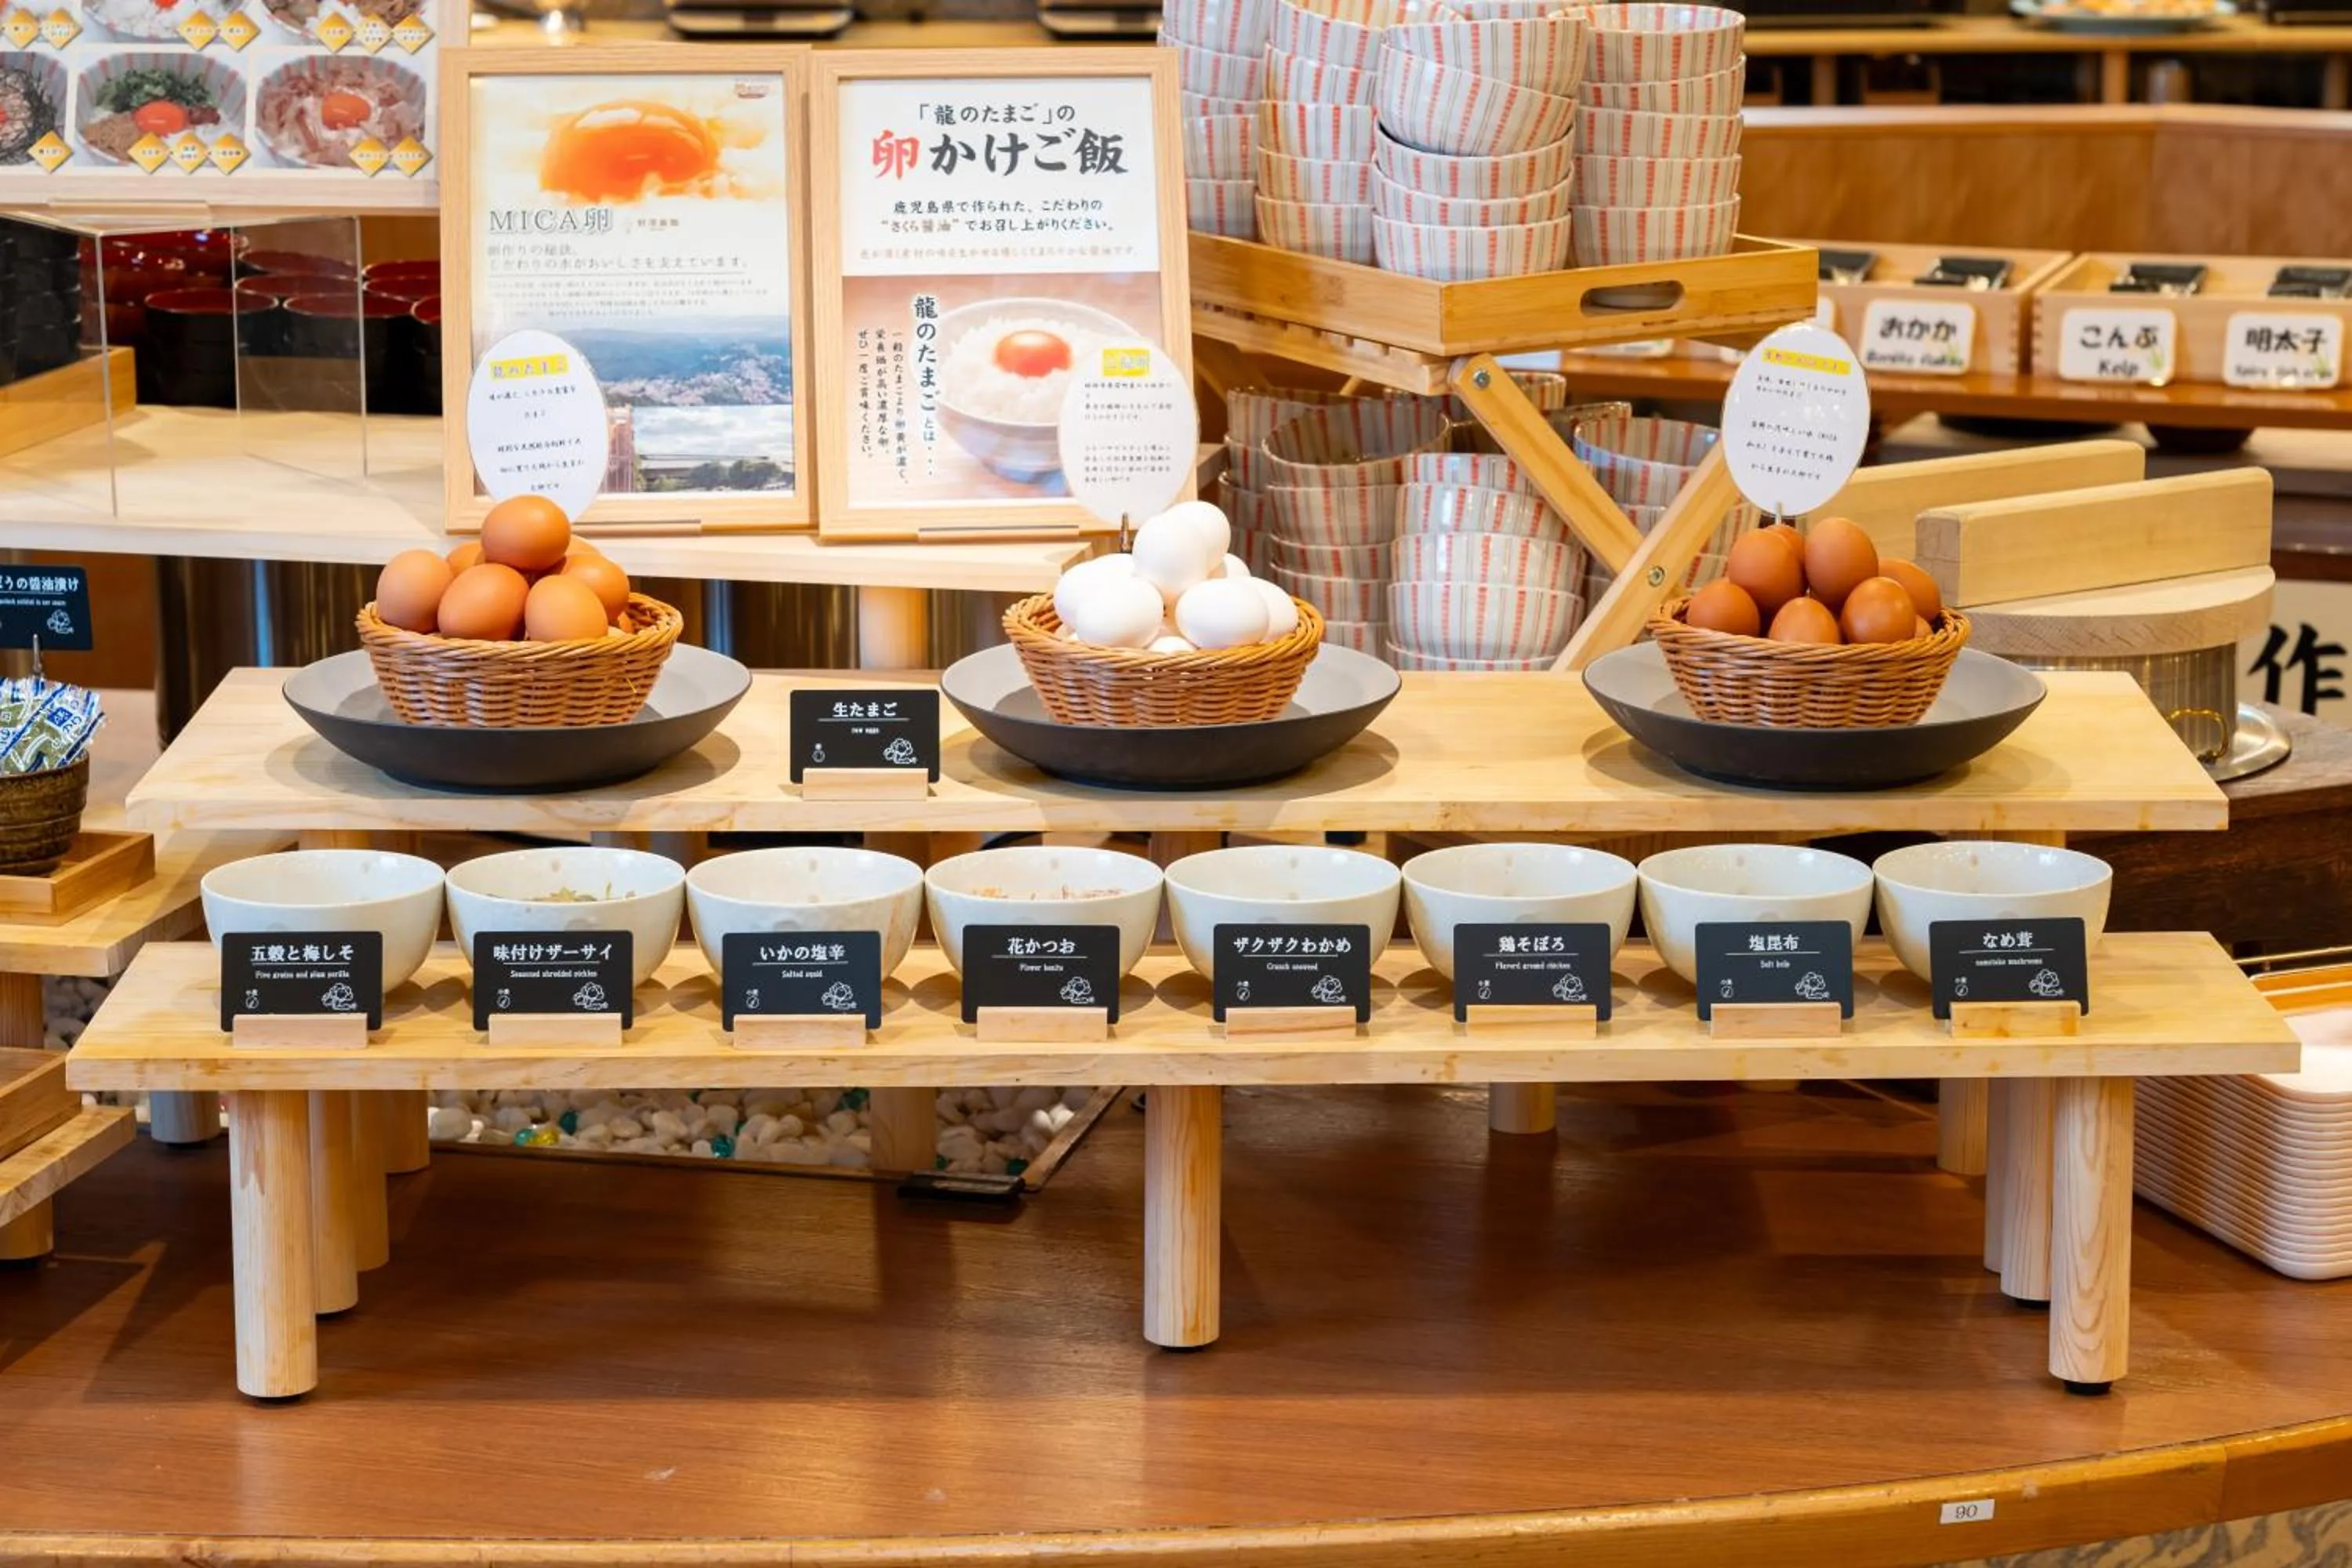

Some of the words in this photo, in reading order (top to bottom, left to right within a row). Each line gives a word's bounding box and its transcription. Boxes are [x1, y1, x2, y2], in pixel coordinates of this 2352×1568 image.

[919, 103, 1076, 125] 「龍のたまご」の
[873, 127, 1129, 180] 卵かけご飯
[893, 200, 1103, 214] 鹿児島県で作られた、こだわりの
[489, 209, 610, 233] MICA卵
[1879, 316, 1957, 343] おかか
[2080, 325, 2158, 348] こんぶ
[2245, 327, 2328, 355] 明太子
[2099, 358, 2139, 378] Kelp
[832, 702, 898, 717] 生たまご
[1007, 938, 1076, 955] 花かつお
[1233, 936, 1352, 953] ザクザクわかめ
[1498, 935, 1565, 953] 鶏そぼろ
[1749, 934, 1799, 951] 塩昆布
[1983, 931, 2033, 949] なめ茸
[250, 944, 354, 963] 五穀と梅しそ
[493, 943, 613, 961] 味付けザーサイ
[760, 944, 845, 961] いかの塩辛
